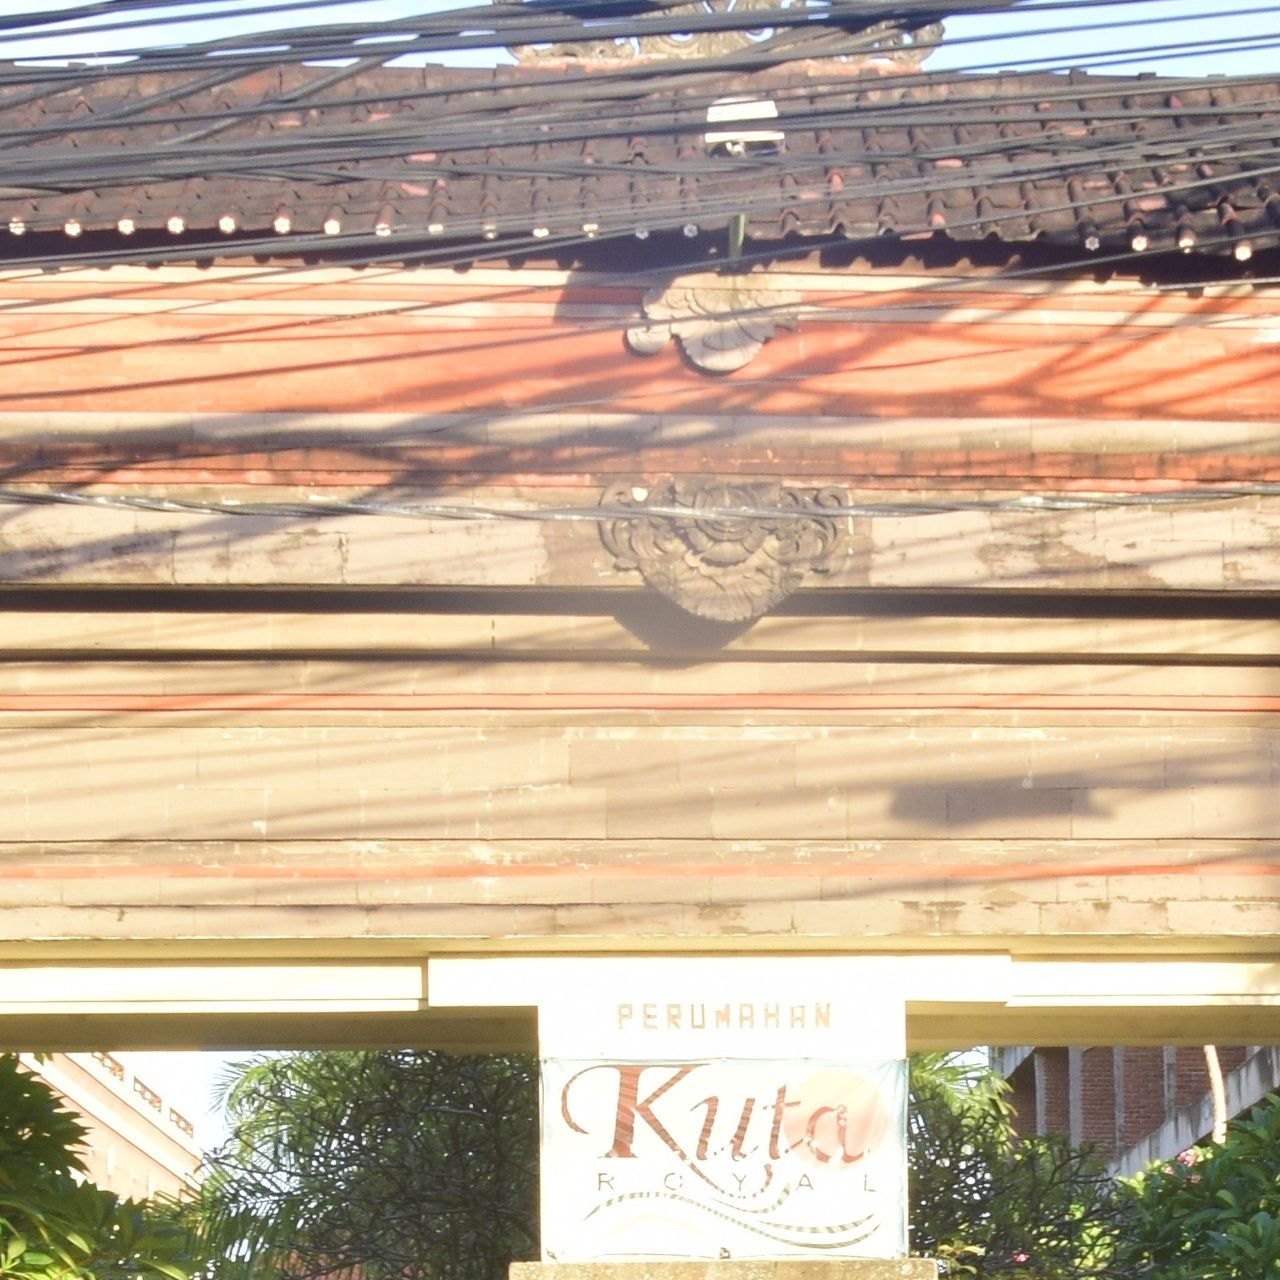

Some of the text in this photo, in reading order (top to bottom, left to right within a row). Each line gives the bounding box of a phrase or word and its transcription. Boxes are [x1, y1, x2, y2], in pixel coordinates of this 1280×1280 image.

[618, 1003, 831, 1030] PERUMAHAN
[561, 1063, 870, 1199] Kuta
[597, 1172, 877, 1192] ROYAL
